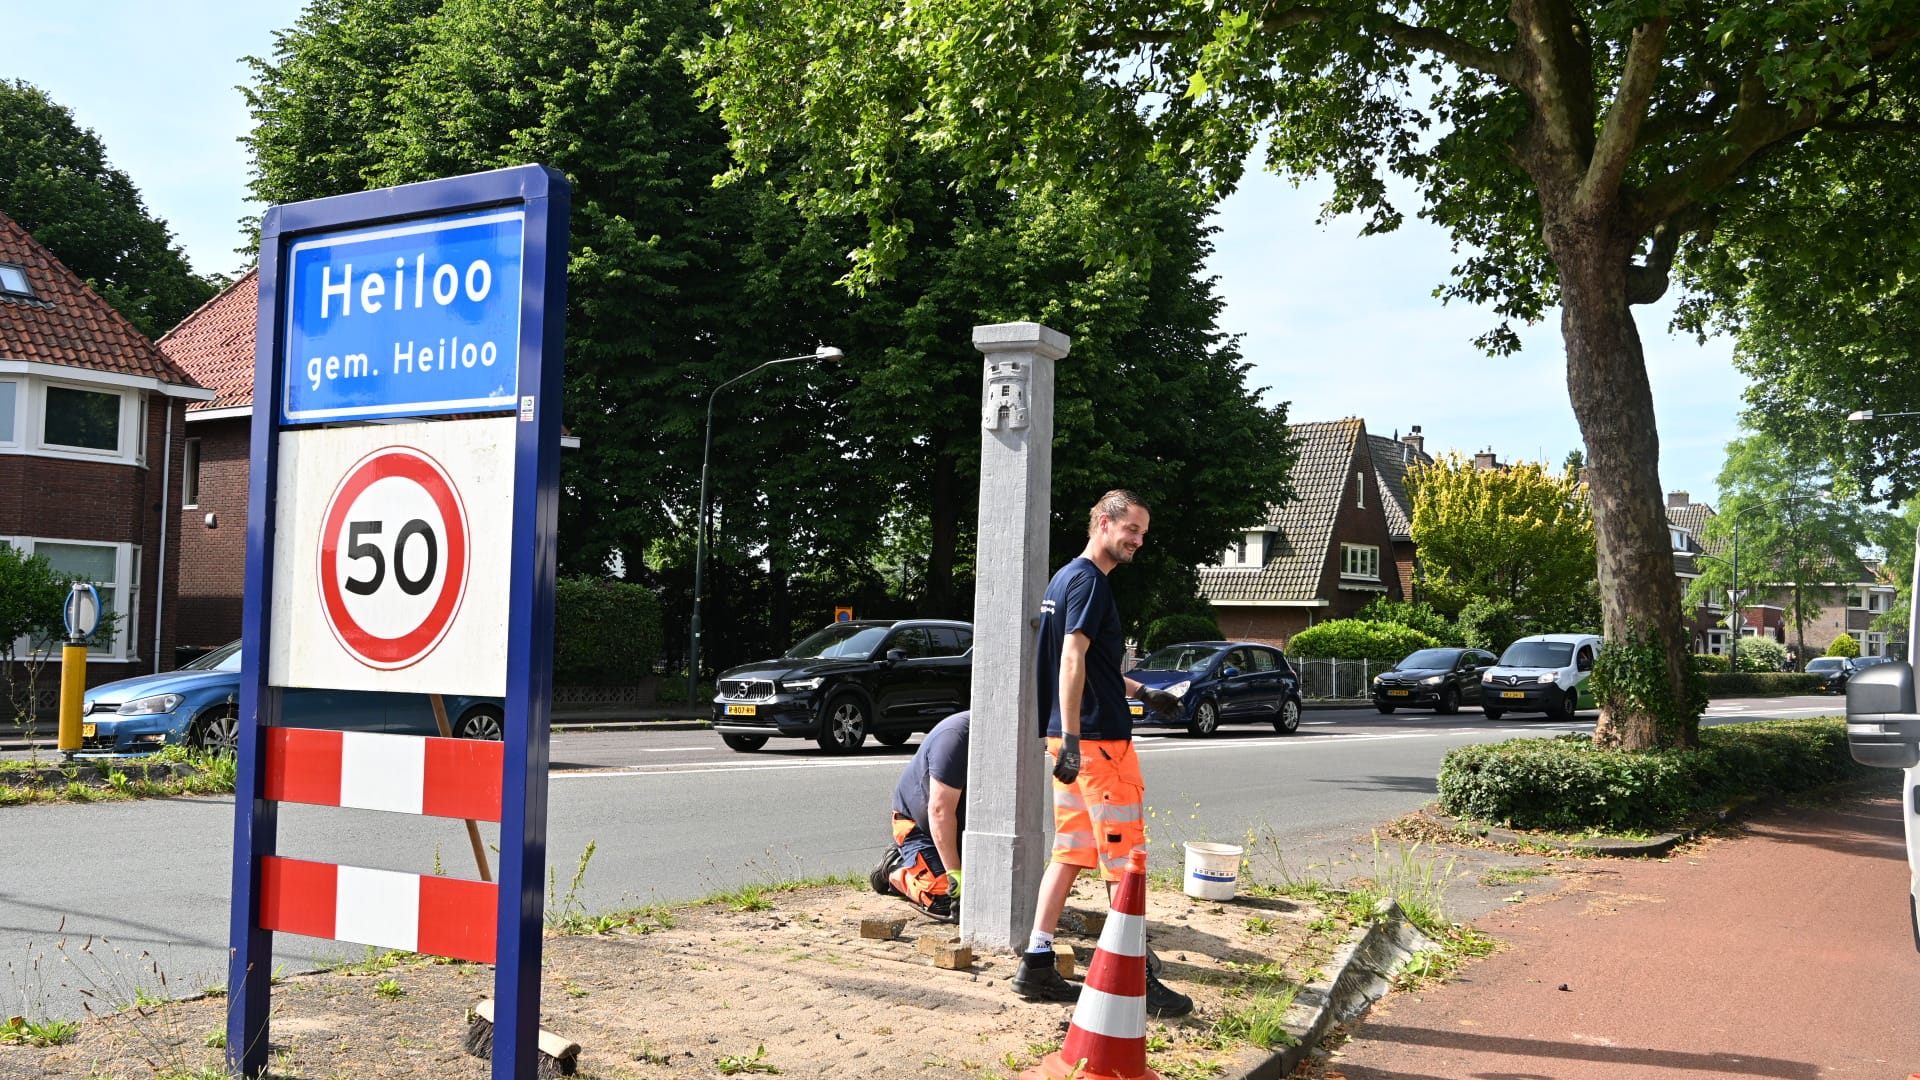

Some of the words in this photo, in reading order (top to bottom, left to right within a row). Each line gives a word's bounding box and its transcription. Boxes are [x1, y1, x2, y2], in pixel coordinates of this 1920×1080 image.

[320, 252, 492, 319] Heiloo
[307, 352, 379, 391] gem.
[393, 336, 497, 375] Heiloo
[344, 518, 438, 596] 50
